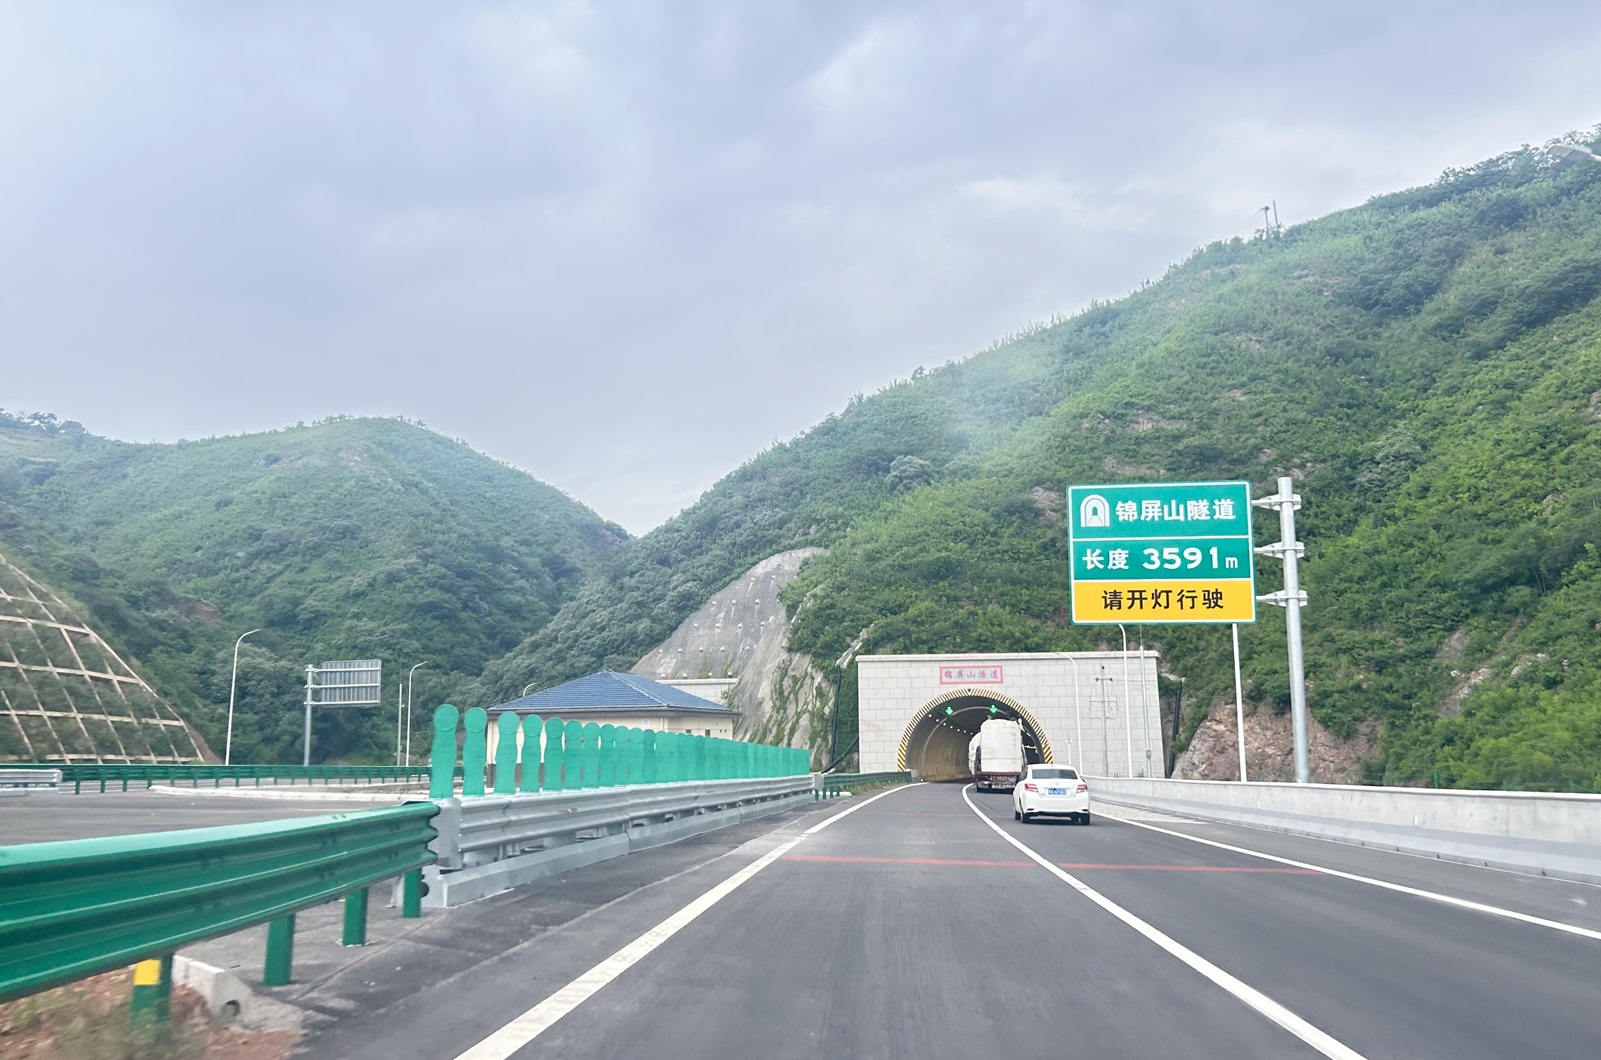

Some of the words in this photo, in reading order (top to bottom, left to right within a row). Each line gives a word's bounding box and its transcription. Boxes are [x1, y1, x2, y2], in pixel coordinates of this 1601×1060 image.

[1115, 498, 1236, 522] 锦屏山隧道
[1082, 548, 1129, 570] 长度
[1101, 588, 1225, 611] 请开灯行驶
